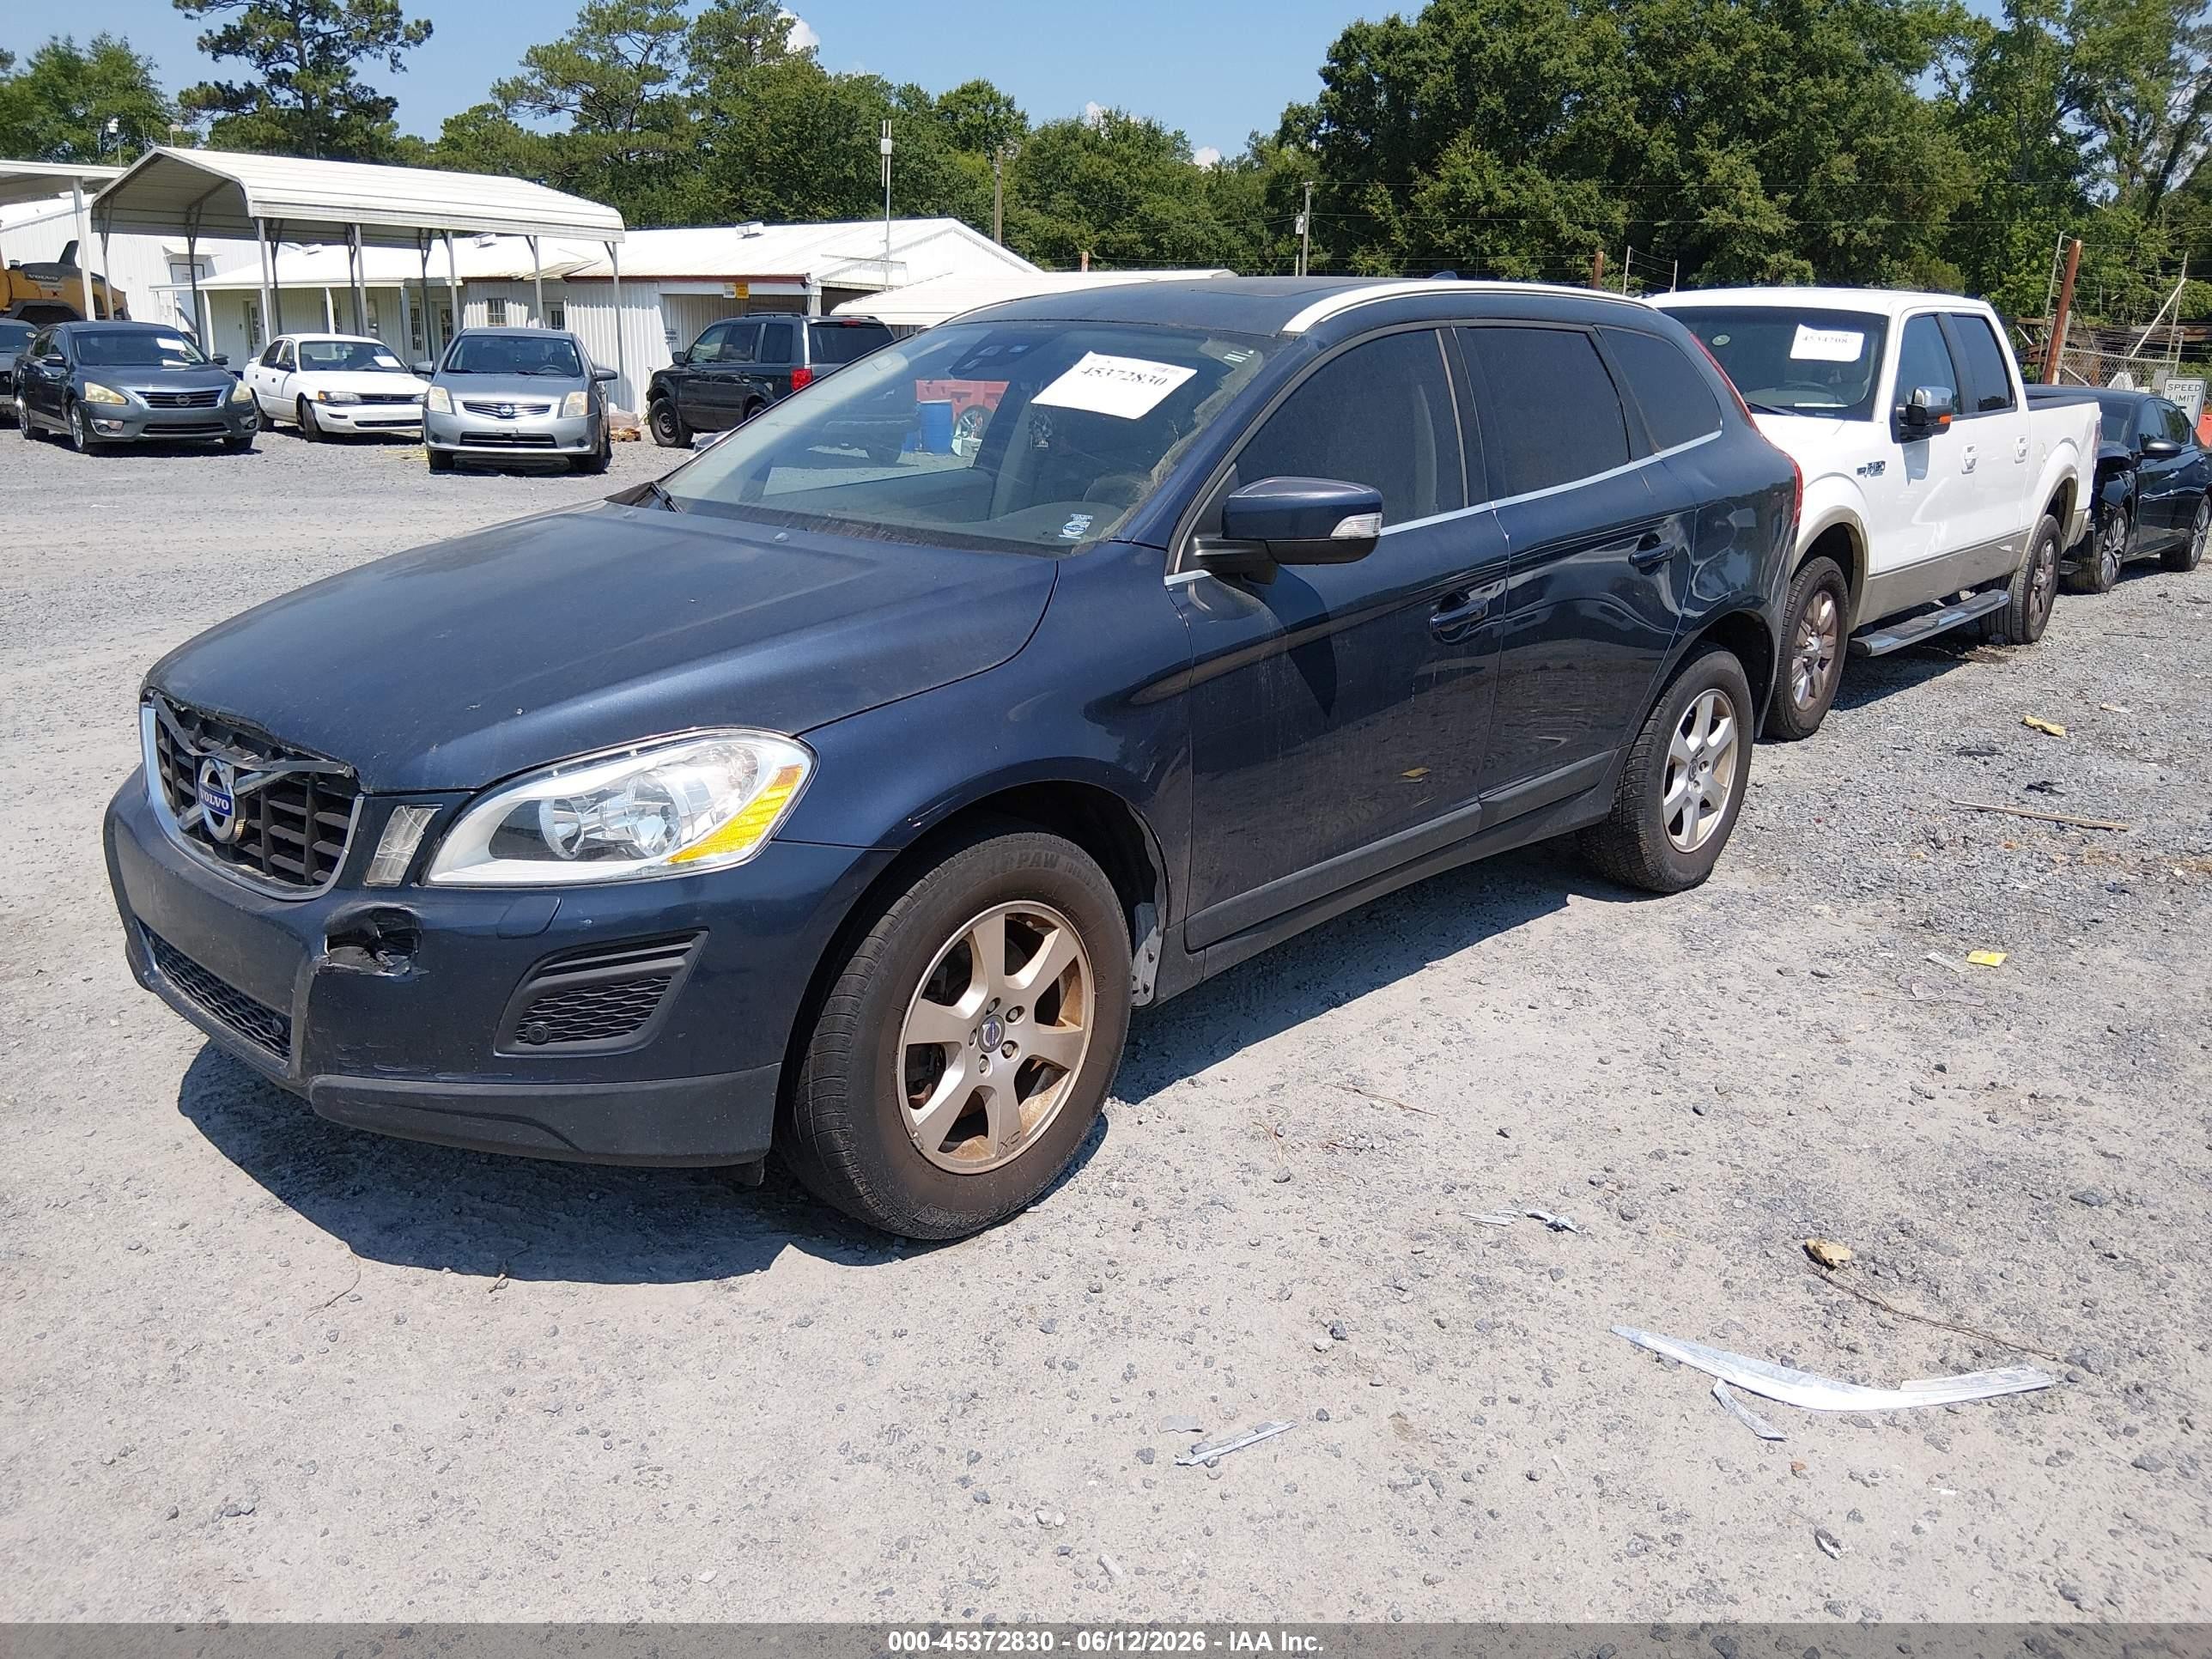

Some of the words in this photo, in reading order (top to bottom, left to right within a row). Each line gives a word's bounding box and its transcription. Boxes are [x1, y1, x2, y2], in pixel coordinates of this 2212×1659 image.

[1081, 367, 1168, 386] 45372830
[2166, 383, 2202, 392] SPEED
[199, 787, 229, 811] VOLVO
